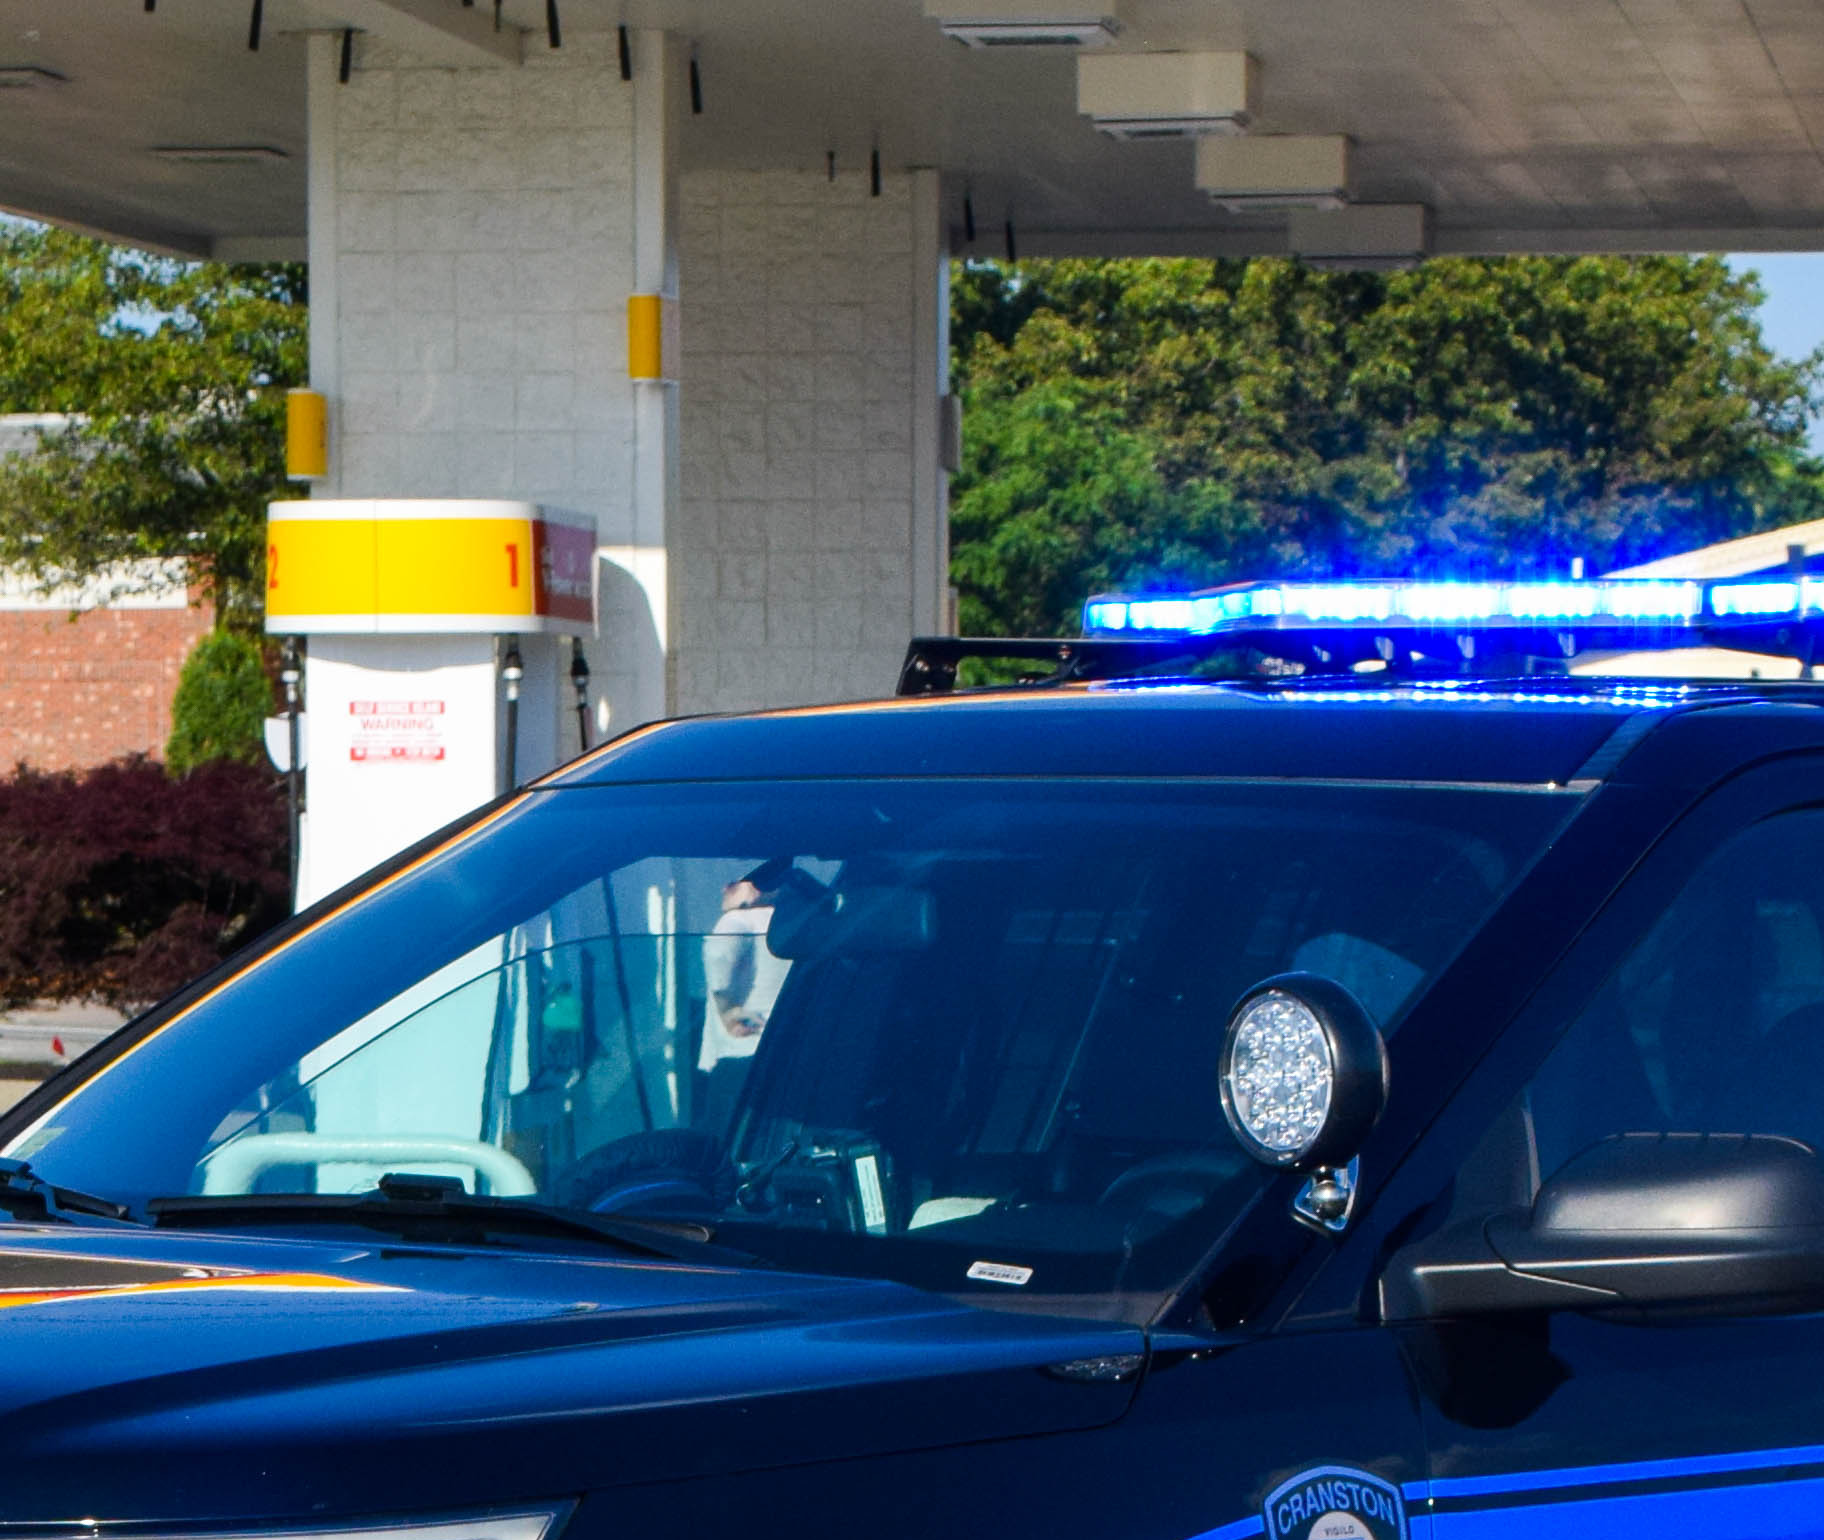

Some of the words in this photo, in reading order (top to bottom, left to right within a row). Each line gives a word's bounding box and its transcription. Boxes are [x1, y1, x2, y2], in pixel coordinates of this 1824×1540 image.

[269, 544, 279, 589] 2
[506, 544, 518, 588] 1
[1278, 1482, 1395, 1534] CRANSTON
